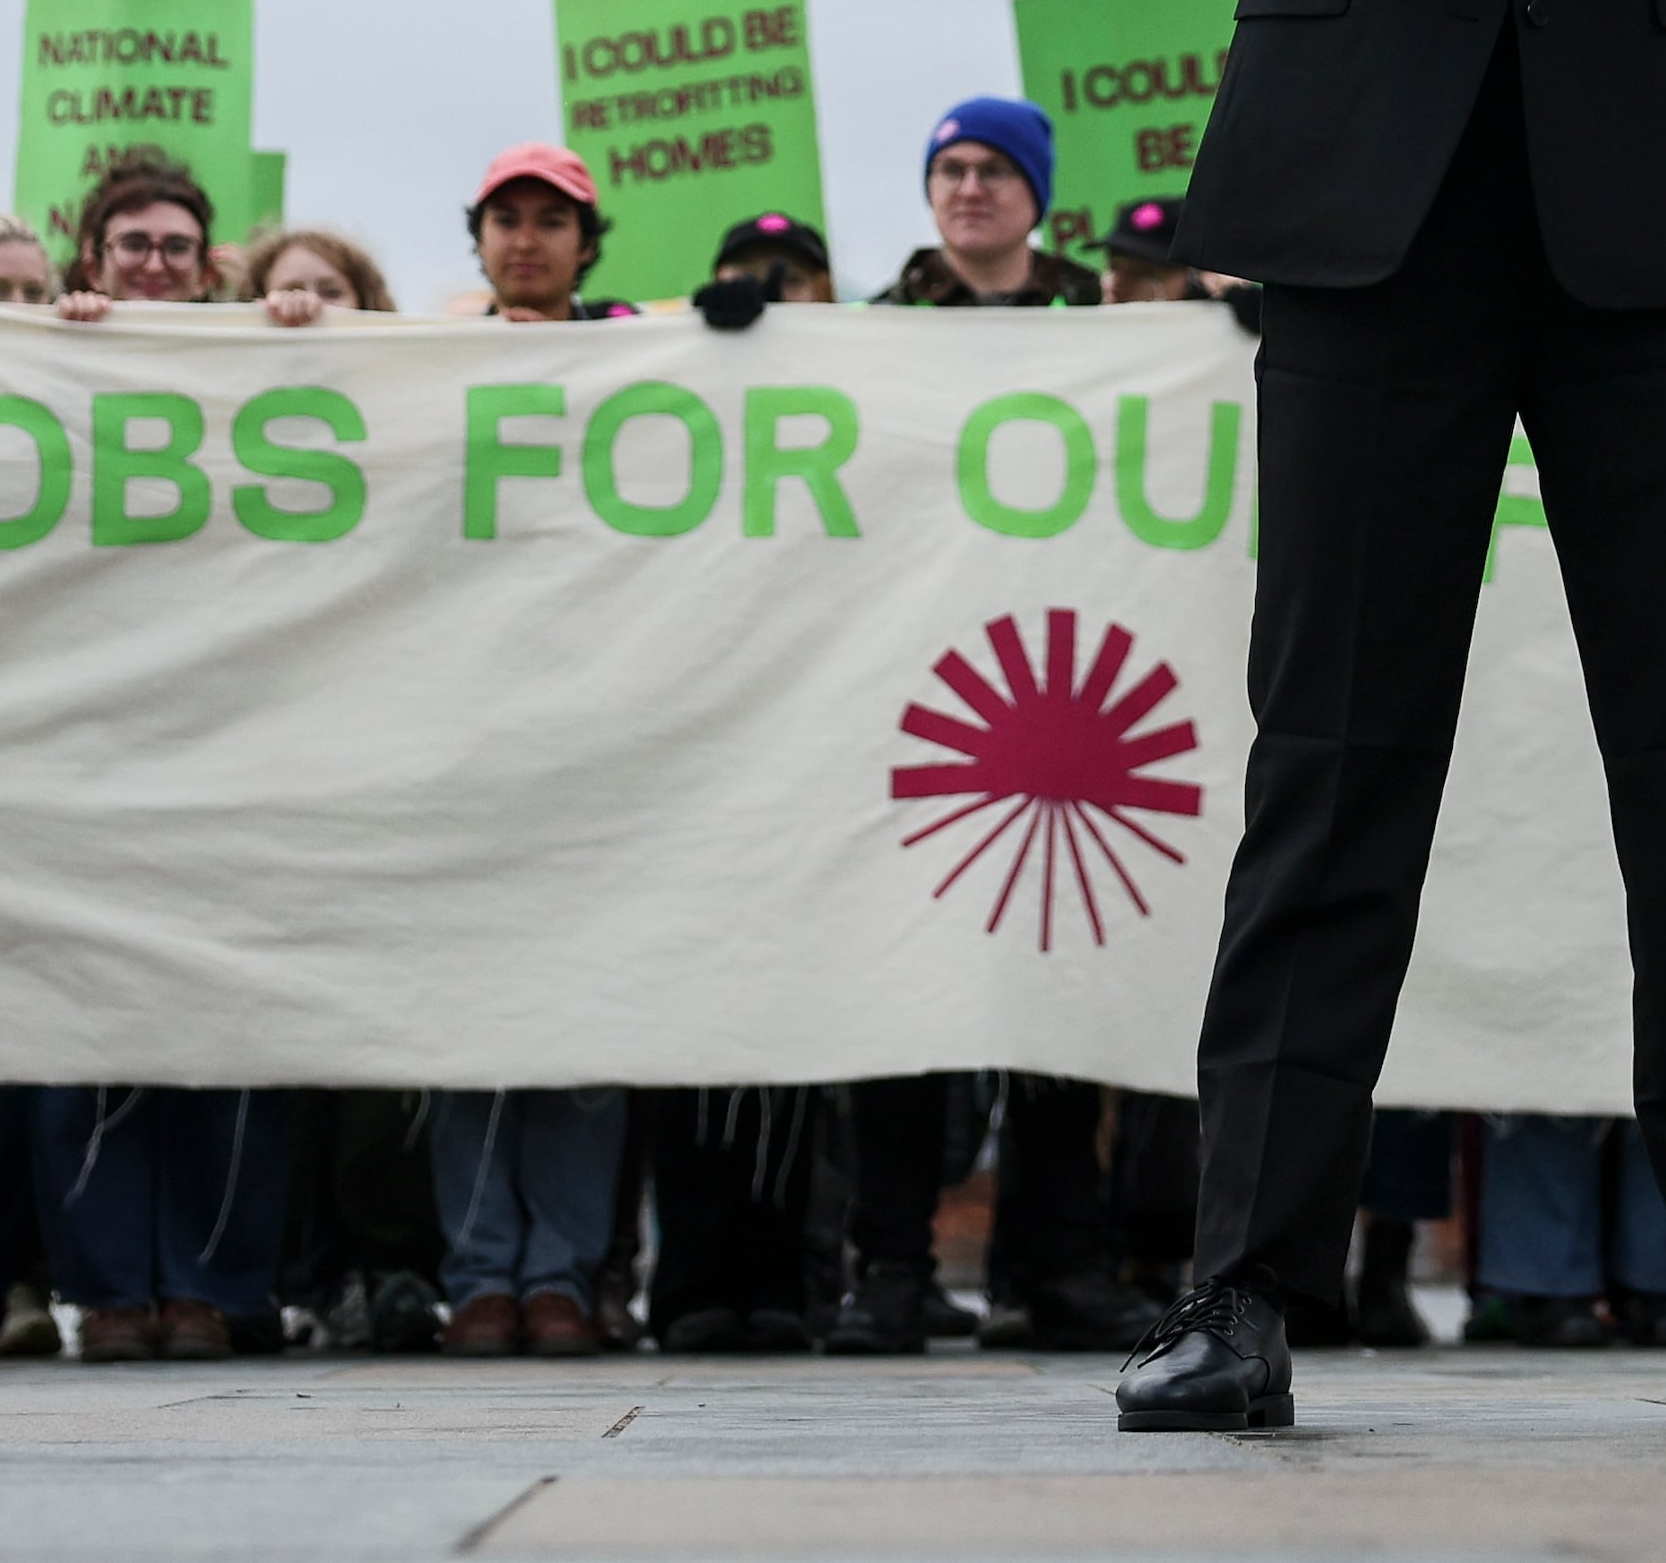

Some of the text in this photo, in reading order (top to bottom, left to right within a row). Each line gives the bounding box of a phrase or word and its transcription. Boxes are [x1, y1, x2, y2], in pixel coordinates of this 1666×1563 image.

[39, 28, 227, 69] NATIONAL
[564, 5, 799, 81] I COULD BE
[48, 86, 213, 126] CLIMATE
[570, 65, 804, 131] RETROFITTING
[1062, 68, 1078, 112] I
[607, 123, 773, 186] HOMES
[1136, 122, 1197, 174] BE
[464, 381, 861, 539] FOR
[956, 392, 1259, 560] OU
